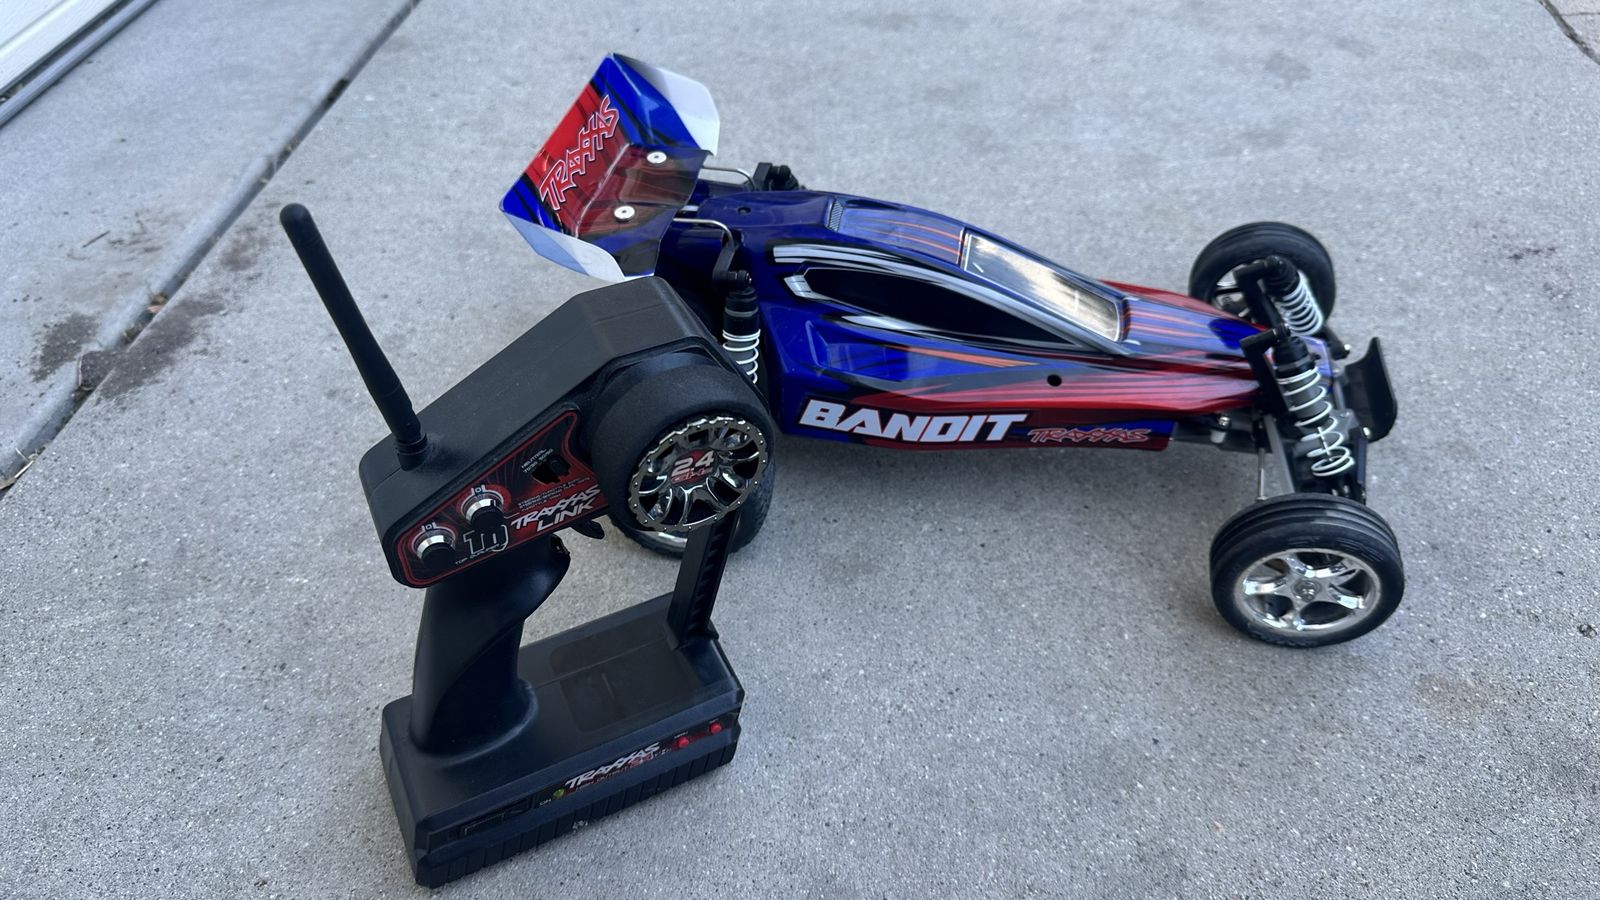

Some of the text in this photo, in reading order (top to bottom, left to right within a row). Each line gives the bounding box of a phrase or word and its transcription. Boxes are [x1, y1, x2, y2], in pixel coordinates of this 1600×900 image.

[539, 94, 619, 211] TRAXXAS
[799, 399, 1028, 443] BANDIT
[1027, 427, 1151, 443] TRAXXAS
[671, 450, 714, 477] 2.4
[511, 484, 600, 529] TRAXXAS
[537, 497, 594, 532] LINK
[564, 742, 660, 788] TRAXXAS
